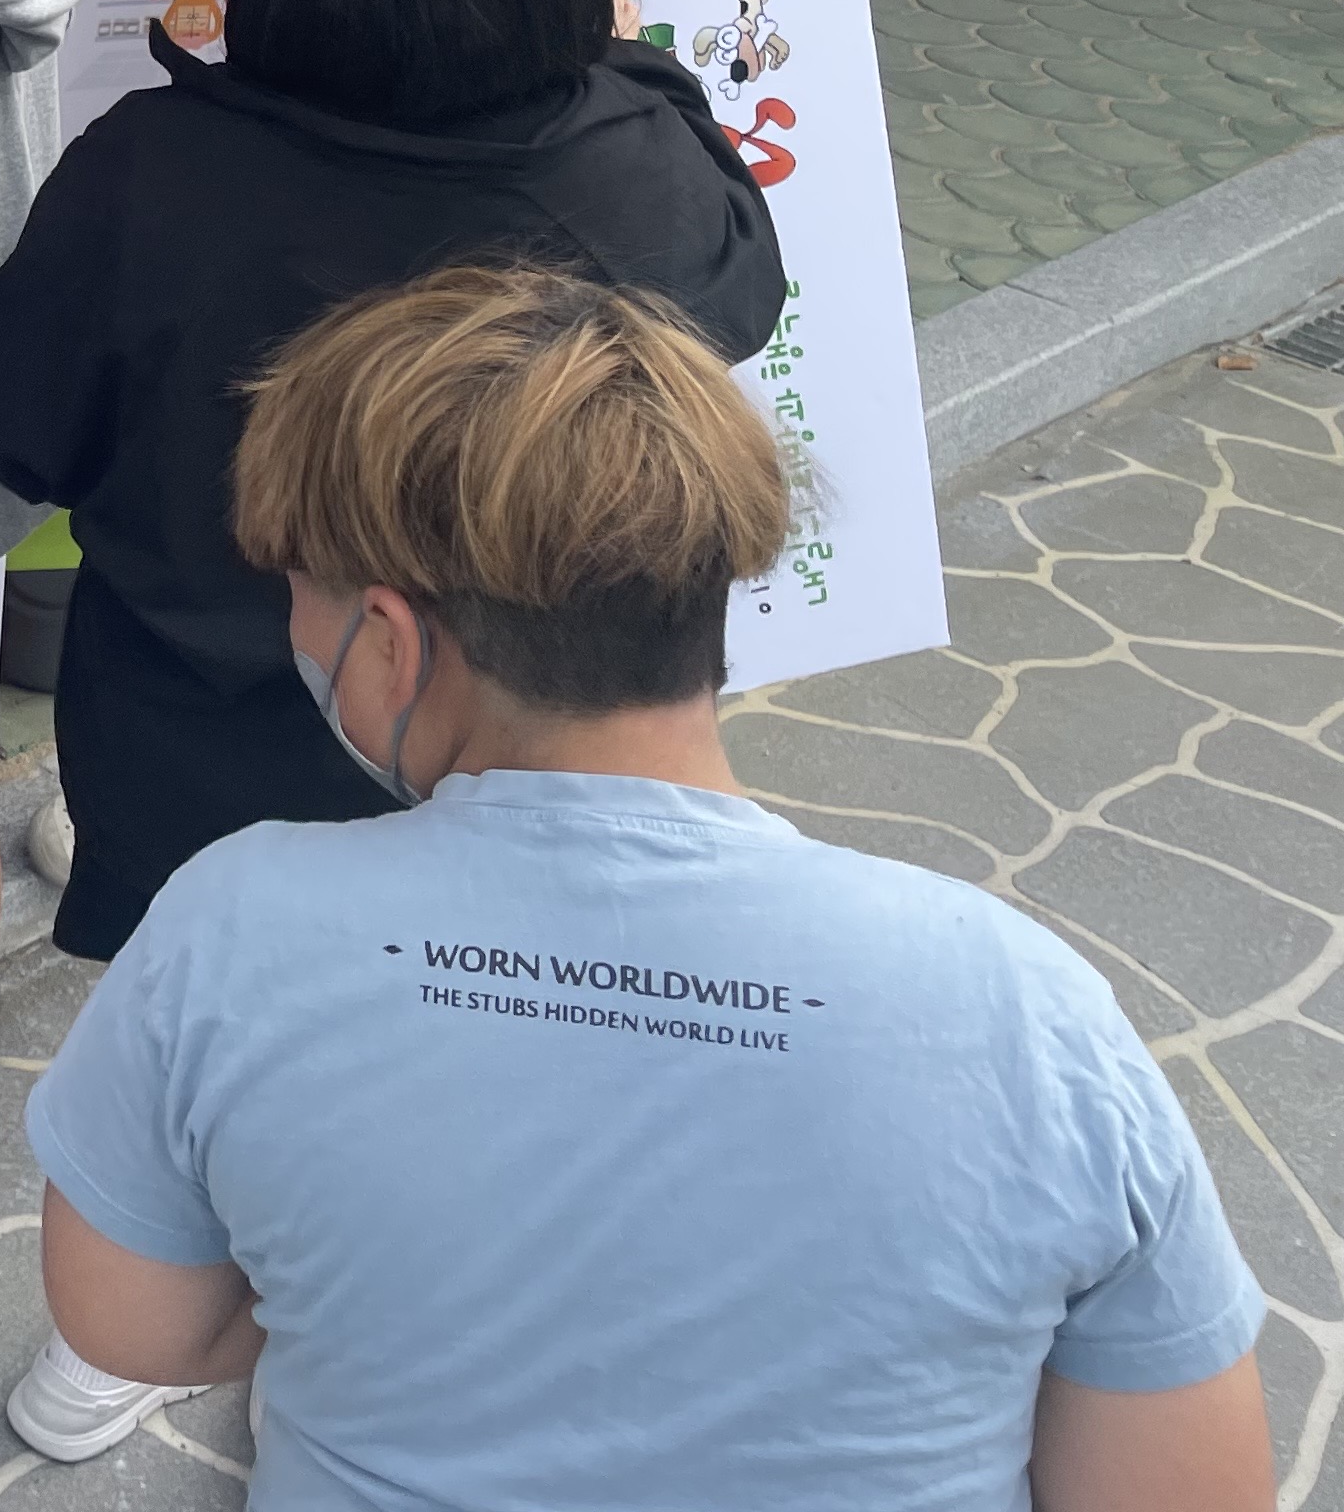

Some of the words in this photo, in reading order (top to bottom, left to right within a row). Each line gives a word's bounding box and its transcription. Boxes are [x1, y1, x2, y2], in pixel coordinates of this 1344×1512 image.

[424, 940, 541, 982] WORN
[550, 955, 792, 1014] WORLDWIDE
[420, 984, 463, 1008] THE
[467, 991, 539, 1019] STUBS
[544, 1001, 639, 1033] HIDDEN
[644, 1015, 735, 1046] WORLD
[740, 1029, 791, 1053] LIVE
